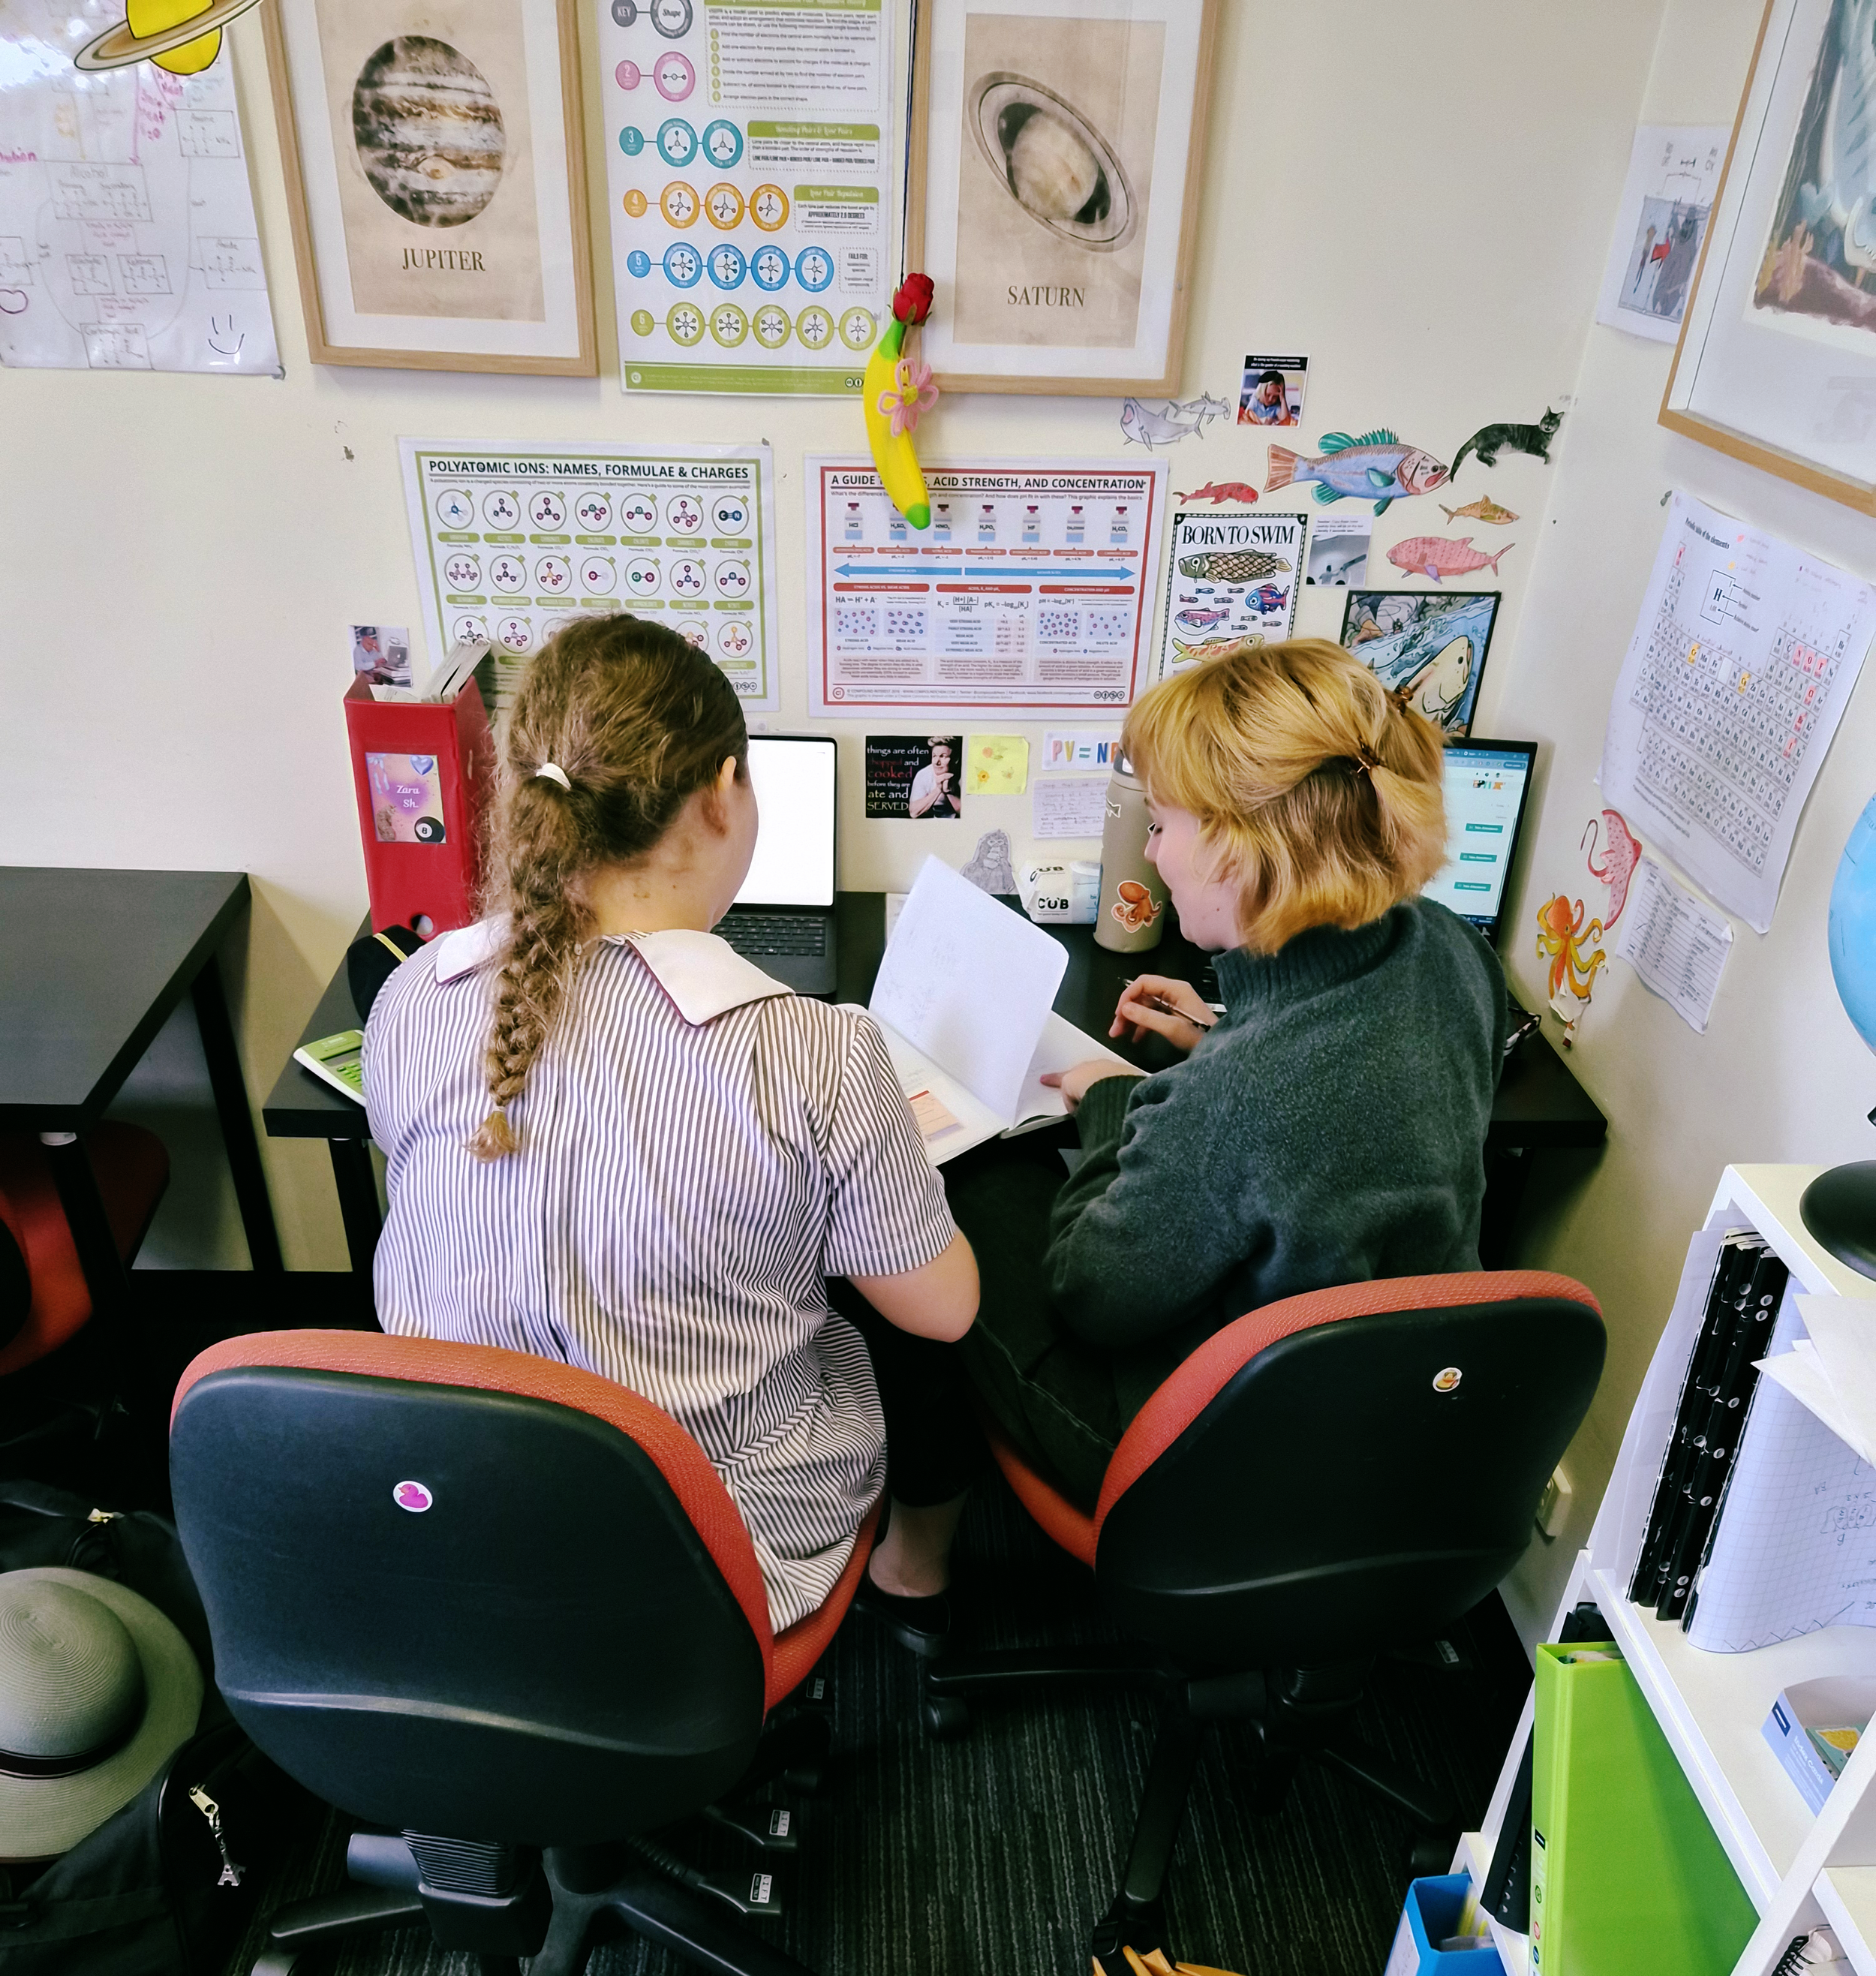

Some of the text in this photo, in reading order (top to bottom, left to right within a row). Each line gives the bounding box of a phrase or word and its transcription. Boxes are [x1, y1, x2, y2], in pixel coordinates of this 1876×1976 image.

[617, 7, 631, 17] KEY
[663, 9, 681, 18] Shape
[624, 65, 630, 77] 2
[628, 131, 634, 143] 3
[632, 194, 639, 206] 4
[403, 248, 486, 272] JUPITER
[636, 254, 642, 266] 5
[1008, 285, 1086, 308] SATURN
[639, 313, 645, 325] 6
[429, 461, 749, 479] POLYATOMIC IONS: NAMES, FORMULAE & CHARGES
[831, 475, 839, 484] A
[842, 475, 875, 485] GUIDE
[933, 477, 958, 486] ACID
[962, 477, 1021, 489] STRENGTH,
[1024, 478, 1048, 487] AND
[1052, 478, 1144, 489] CONCENTRATION
[1181, 525, 1295, 545] BORN TO SWIM
[1713, 588, 1723, 602] H
[867, 744, 891, 757] things
[907, 745, 929, 754] often
[904, 757, 919, 765] and
[868, 766, 912, 778] cooked
[396, 785, 420, 795] Zara
[887, 780, 900, 789] they
[868, 786, 909, 799] ate and
[867, 802, 909, 811] SERVED
